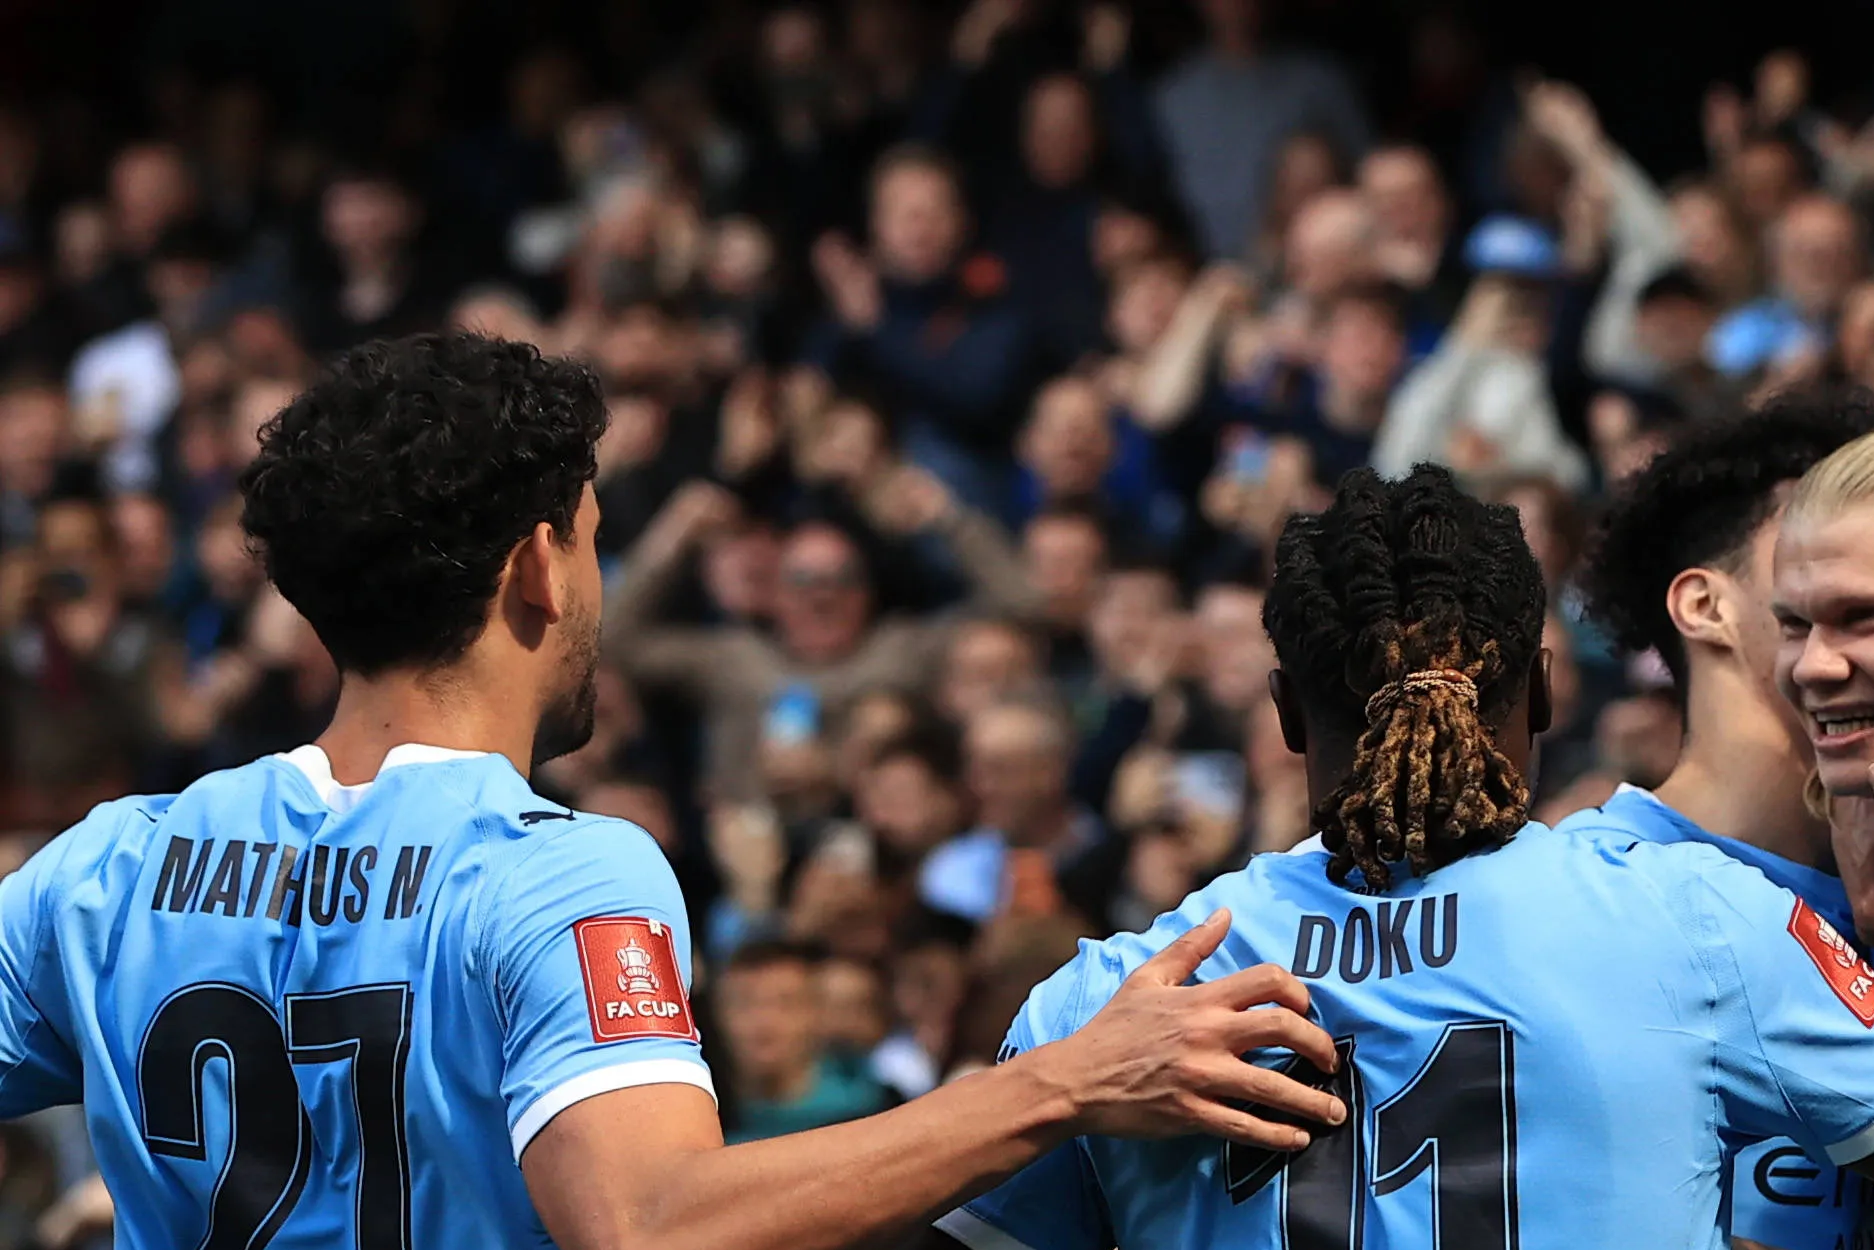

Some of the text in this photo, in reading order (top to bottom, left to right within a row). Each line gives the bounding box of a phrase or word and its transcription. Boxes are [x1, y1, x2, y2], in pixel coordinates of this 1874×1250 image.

[1291, 892, 1459, 984] DOKU
[1849, 975, 1873, 1000] FA
[606, 999, 681, 1020] FA CUP
